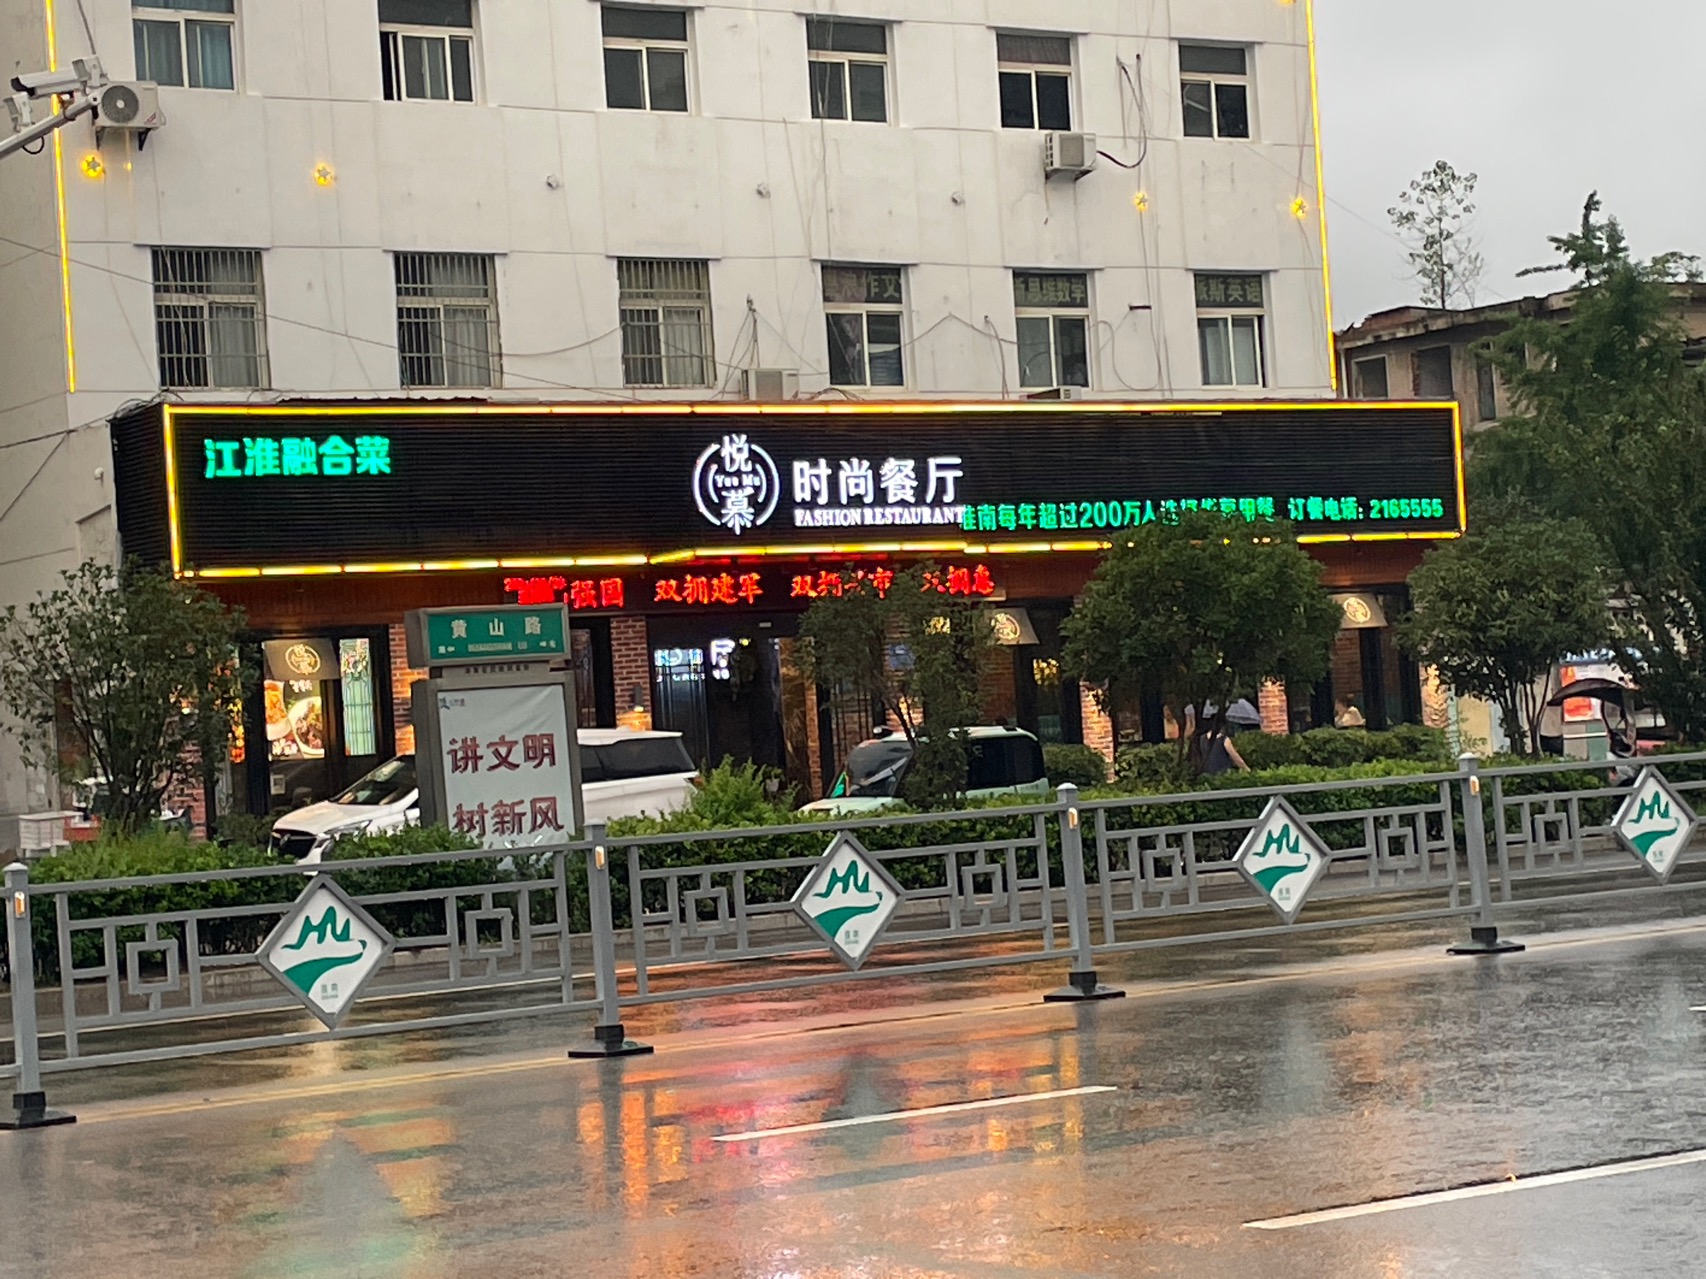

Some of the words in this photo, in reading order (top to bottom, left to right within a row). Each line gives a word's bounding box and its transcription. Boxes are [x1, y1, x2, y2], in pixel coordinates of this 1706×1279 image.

[204, 435, 391, 478] 江淮融合菜
[721, 434, 753, 473] 悦
[793, 457, 964, 505] 时尚餐厅
[795, 508, 861, 527] FASHION
[863, 504, 965, 525] RESTAURANT
[451, 616, 541, 639] 黄山路
[447, 733, 557, 774] 讲文明
[452, 796, 565, 839] 树新风
